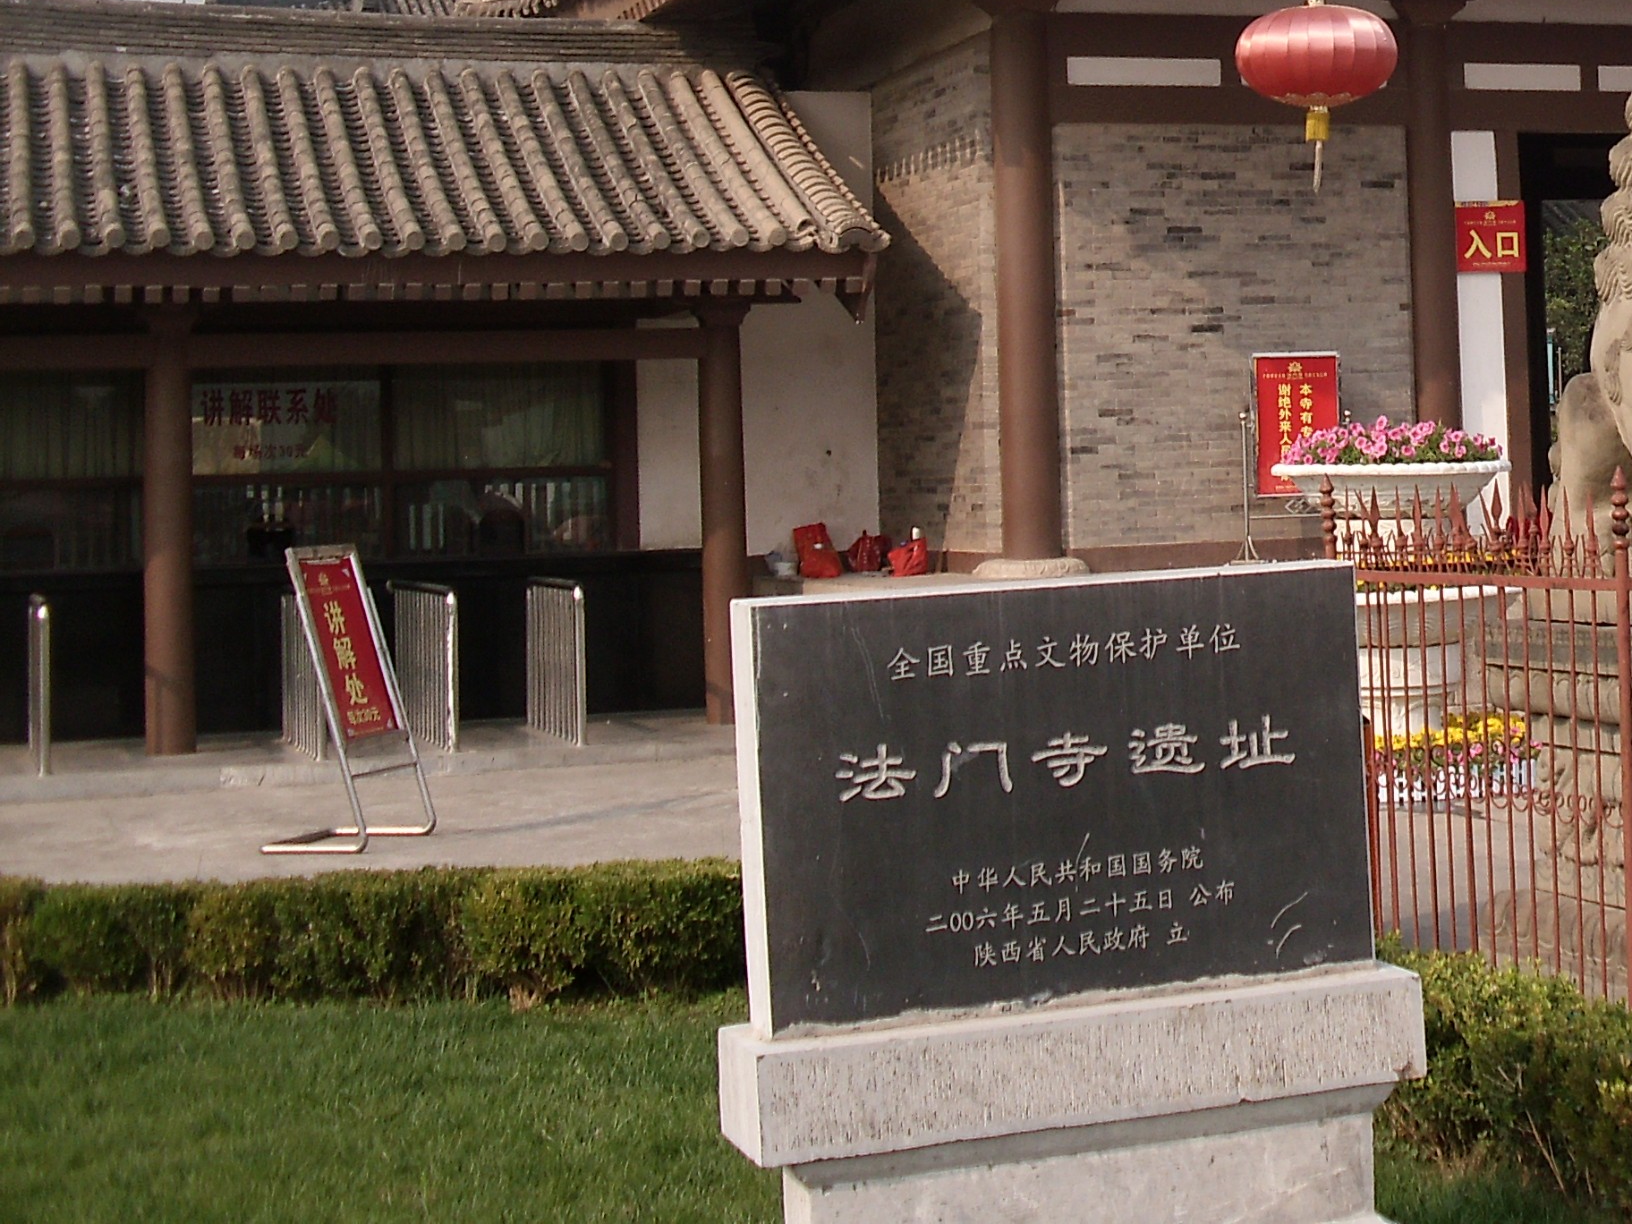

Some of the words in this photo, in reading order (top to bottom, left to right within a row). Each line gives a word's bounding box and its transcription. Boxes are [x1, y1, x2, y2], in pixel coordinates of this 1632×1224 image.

[1464, 229, 1519, 259] 入口
[201, 388, 337, 426] 讲解联系处
[323, 600, 368, 706] 讲解处
[887, 622, 1241, 681] 全国重点文物保护单位
[835, 714, 1296, 802] 法门寺遗址
[951, 845, 1204, 895] 中华人民共和国国务院
[1188, 879, 1236, 908] 公布
[973, 923, 1150, 968] 陕西省人民政府
